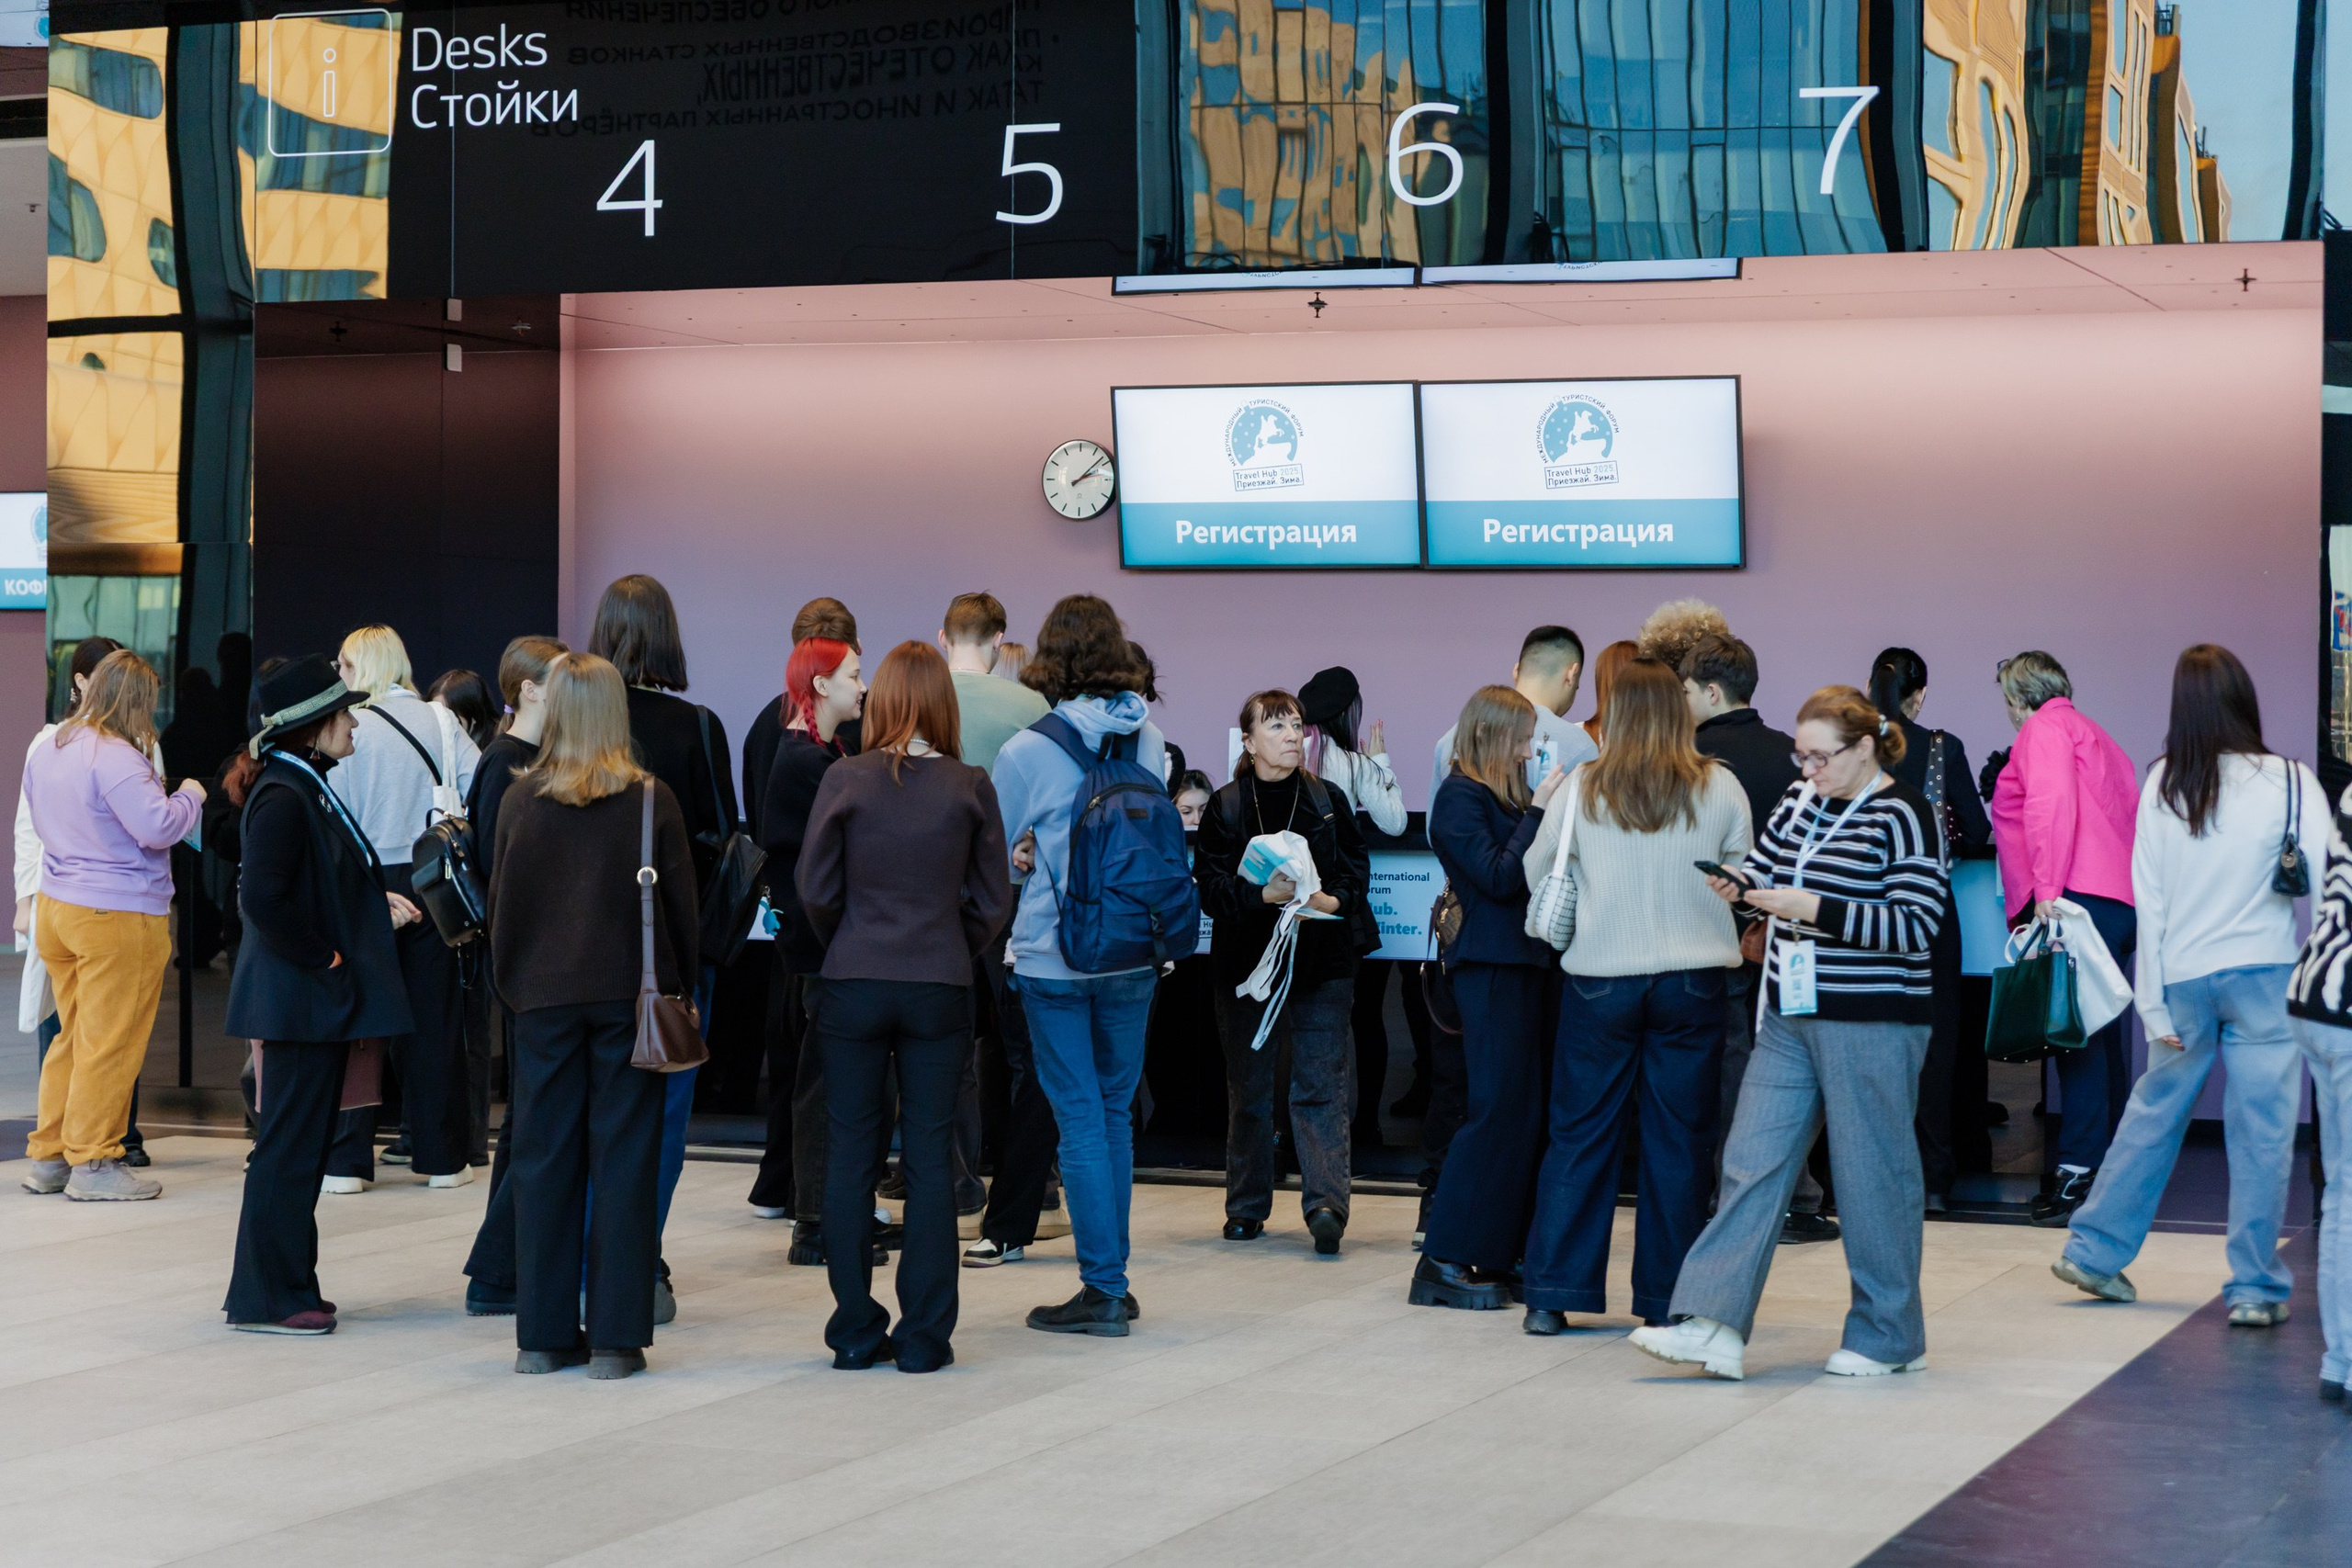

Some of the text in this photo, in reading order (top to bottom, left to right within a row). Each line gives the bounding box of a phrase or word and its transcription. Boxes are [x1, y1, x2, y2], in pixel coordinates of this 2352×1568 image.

[412, 23, 548, 72] Desks
[411, 79, 577, 129] Стойки
[1388, 102, 1463, 206] 6
[1799, 86, 1879, 194] 7
[595, 140, 663, 237] 4
[995, 122, 1064, 224] 5
[1224, 399, 1304, 467] МЕЖДУНАРОДНЫЙ ТУРИСТСКИЙ ФОРУМ
[1536, 394, 1620, 464] МЕЖДУНАРОДНЫЙ ТУРИСТСКИЙ ФОРУМ
[1236, 470, 1261, 480] Travel
[1261, 469, 1278, 478] Hub
[1237, 476, 1302, 490] Приезжай. Зима.
[1547, 468, 1572, 478] Travel
[1575, 467, 1591, 476] Hub
[1548, 474, 1617, 487] Приезжай. Зима.
[1176, 519, 1357, 550] Регистрация
[1483, 517, 1674, 549] Регистрация
[1369, 872, 1430, 882] nternational
[1369, 886, 1391, 895] rum
[1370, 902, 1398, 916] ub.
[1378, 921, 1422, 935] inter.
